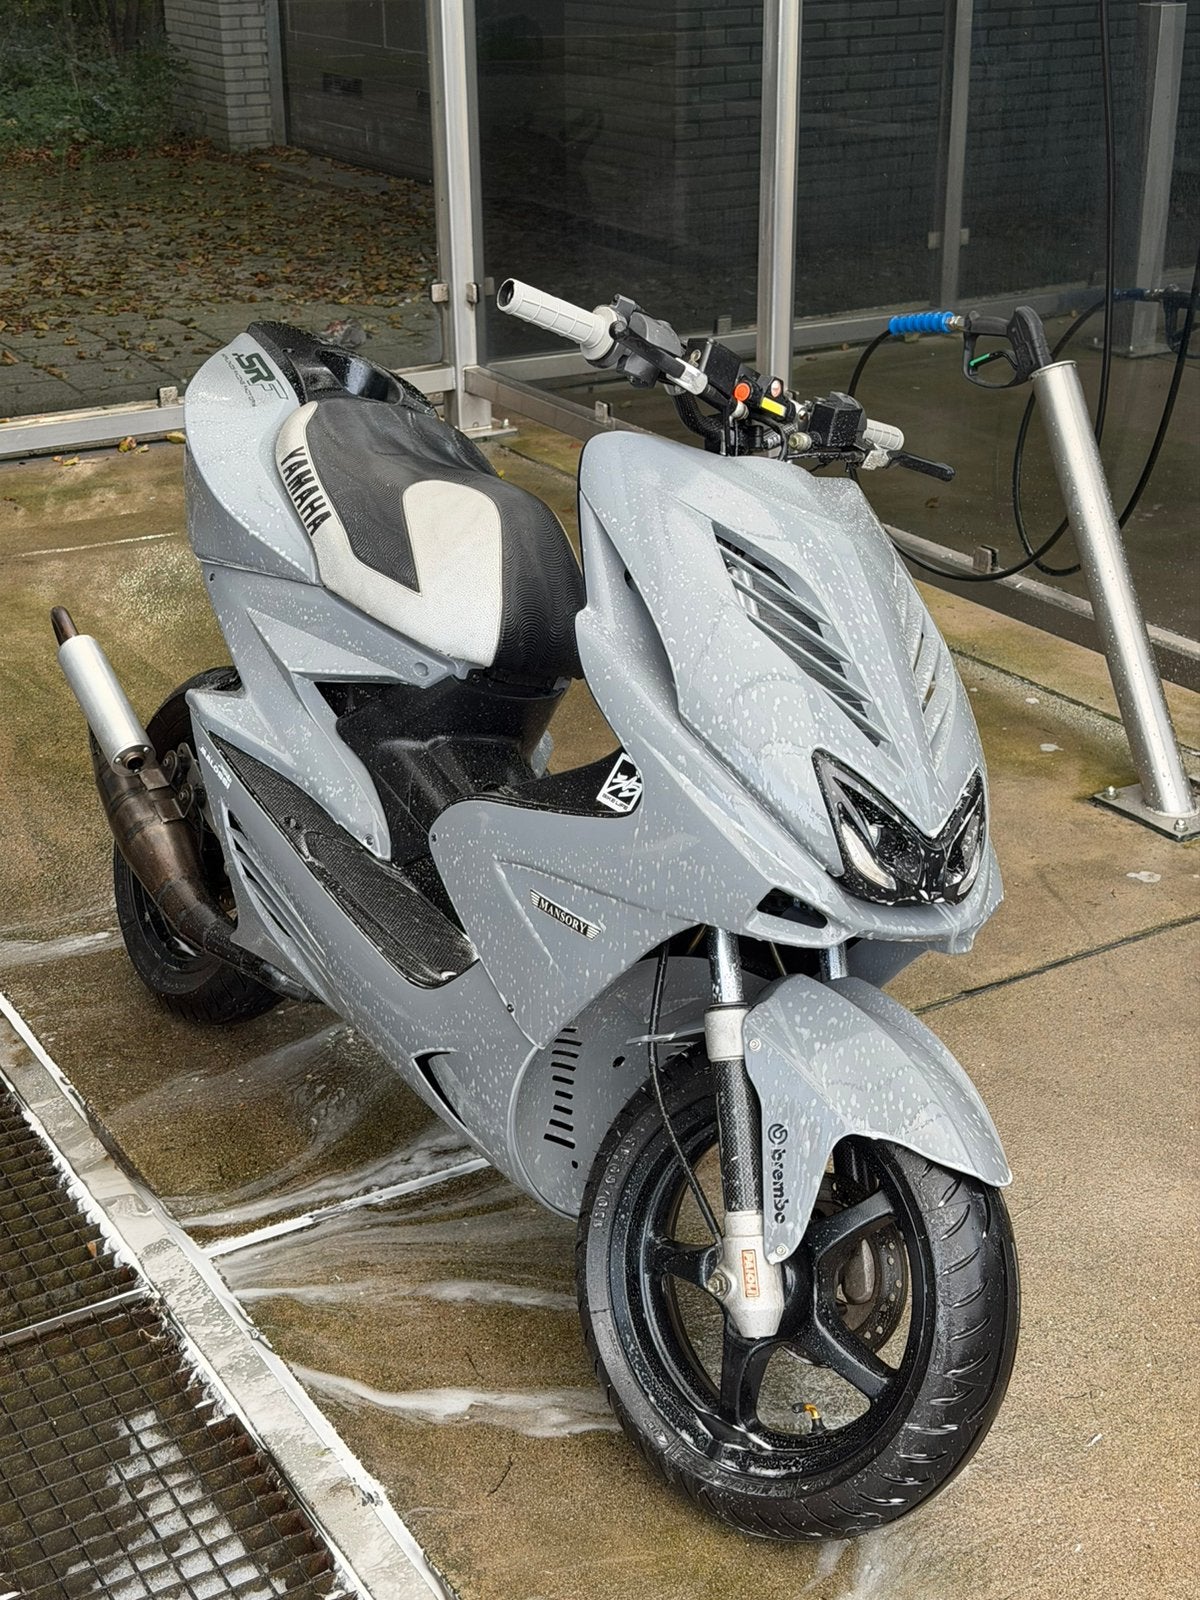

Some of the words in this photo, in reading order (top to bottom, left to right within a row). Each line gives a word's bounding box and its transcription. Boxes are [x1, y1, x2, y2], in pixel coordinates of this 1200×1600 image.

[280, 446, 332, 536] YAMAHA
[538, 898, 588, 935] MANSORY
[771, 1149, 789, 1225] brembo
